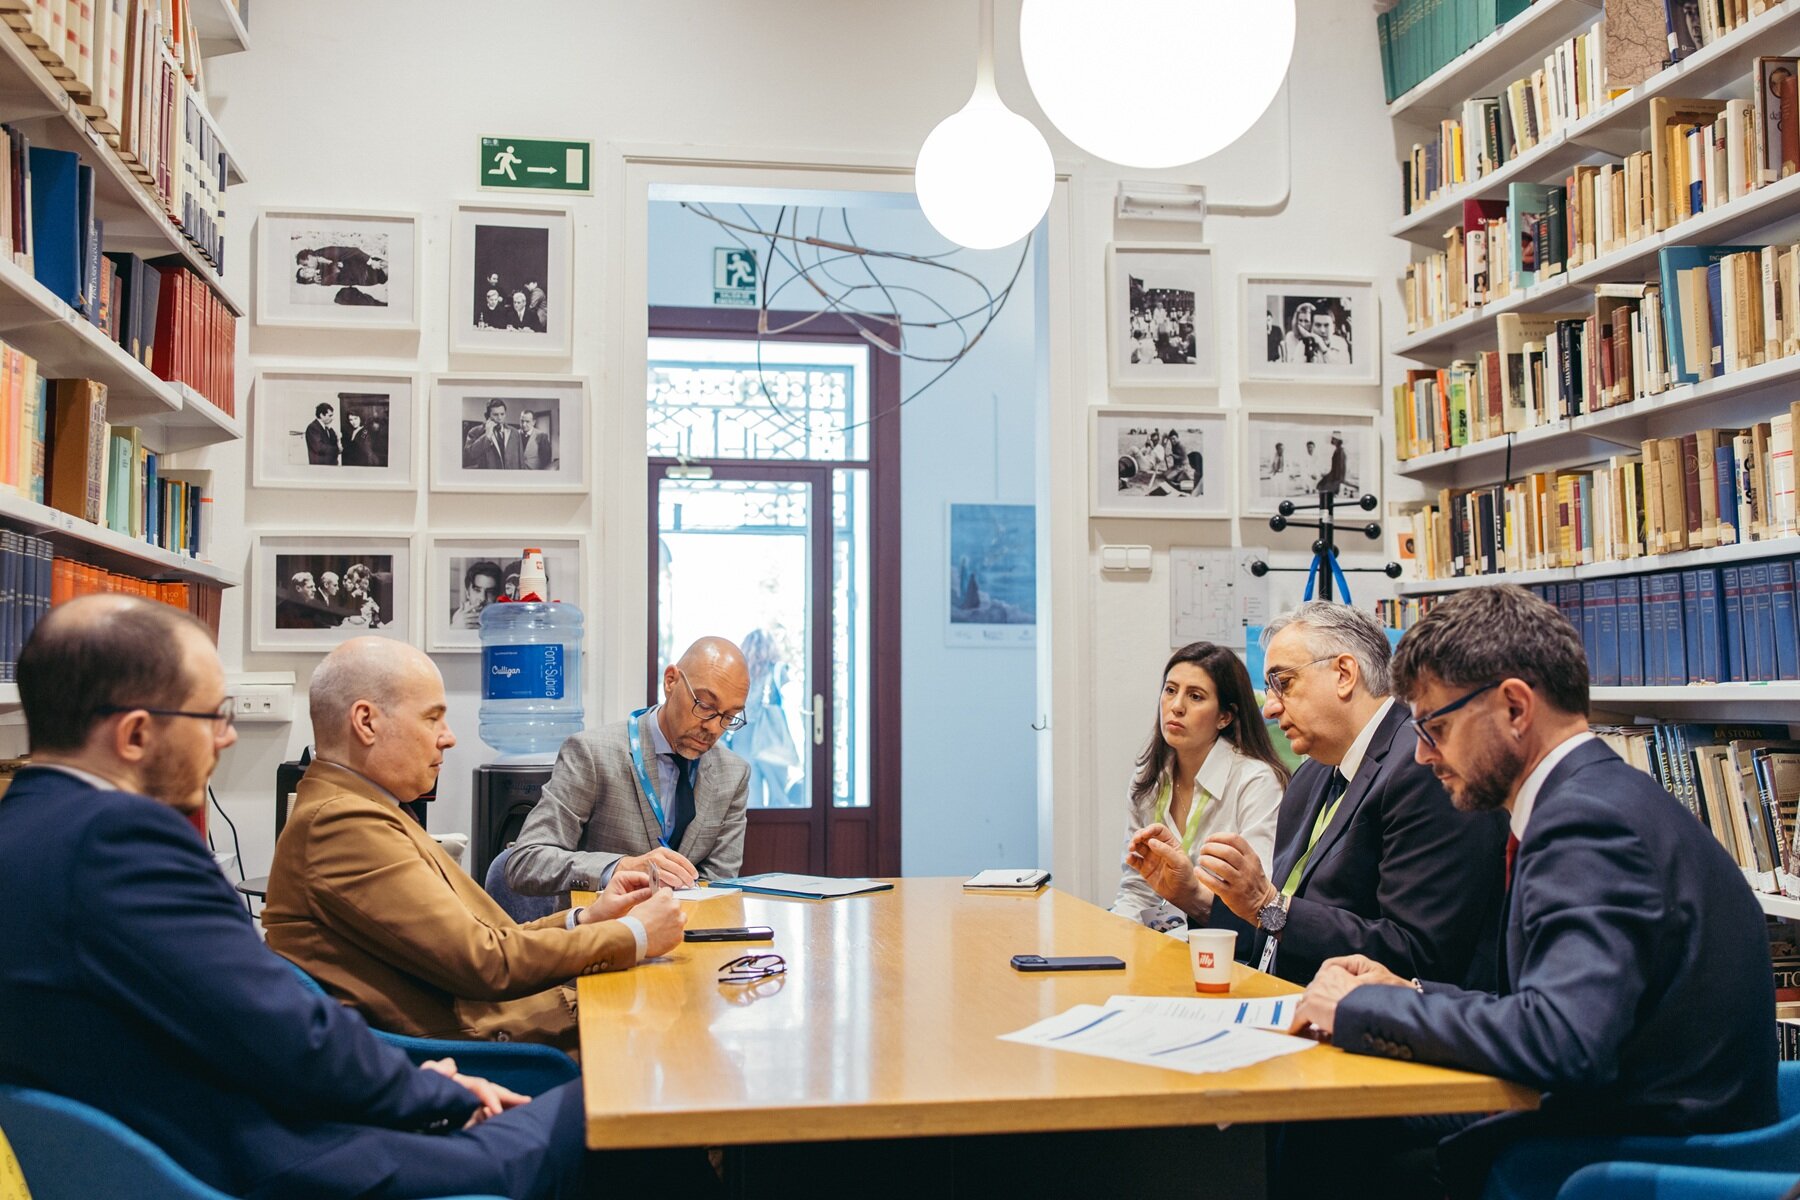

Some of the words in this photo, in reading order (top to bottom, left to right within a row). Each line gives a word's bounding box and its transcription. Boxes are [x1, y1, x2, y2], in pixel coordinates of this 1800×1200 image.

[491, 665, 521, 678] Culligan
[1714, 729, 1726, 738] LA
[1728, 728, 1762, 738] STORIA
[1773, 819, 1786, 852] Scala
[1200, 954, 1213, 967] illy
